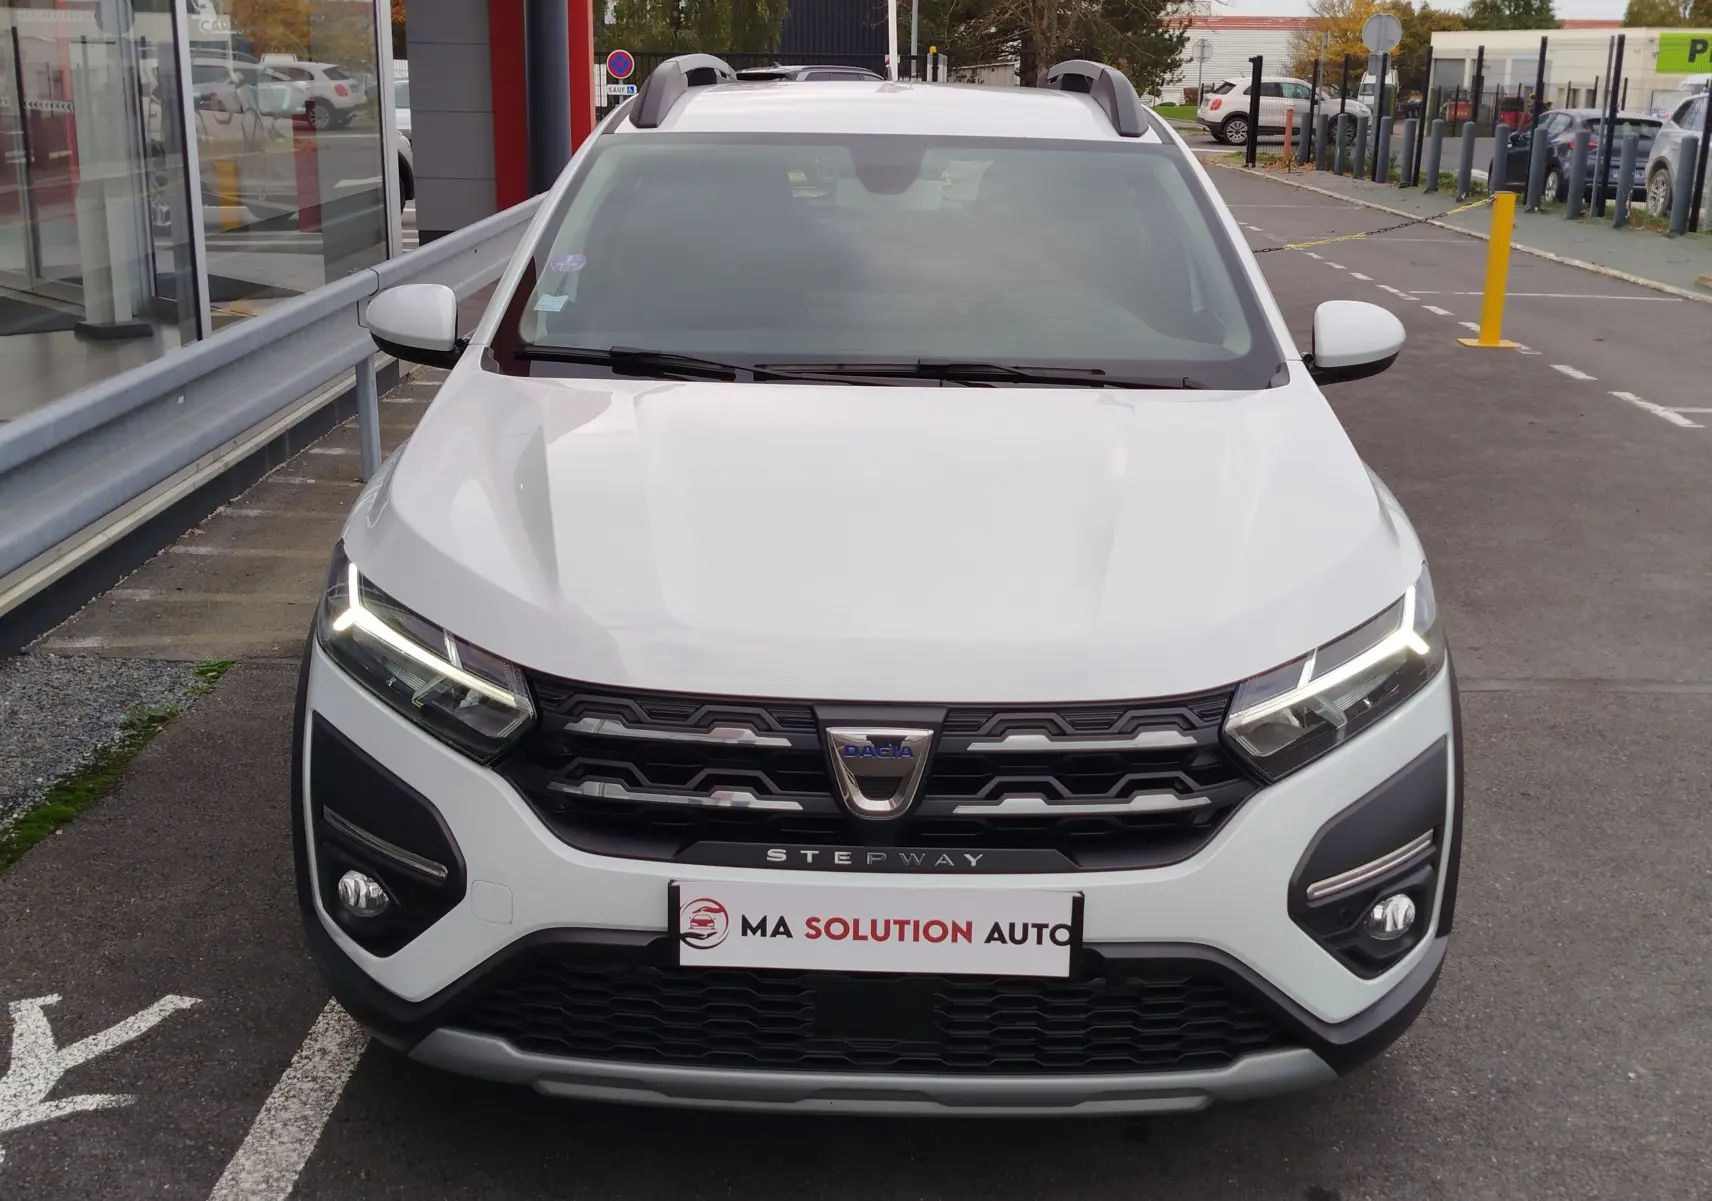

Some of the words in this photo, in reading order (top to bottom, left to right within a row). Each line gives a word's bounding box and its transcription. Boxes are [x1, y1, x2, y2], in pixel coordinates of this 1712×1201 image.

[1688, 38, 1712, 63] P
[843, 743, 914, 759] DACIA
[766, 848, 983, 867] STEPWAY
[741, 914, 794, 939] MA
[804, 916, 973, 944] SOLUTION
[984, 921, 1072, 947] AUTO
